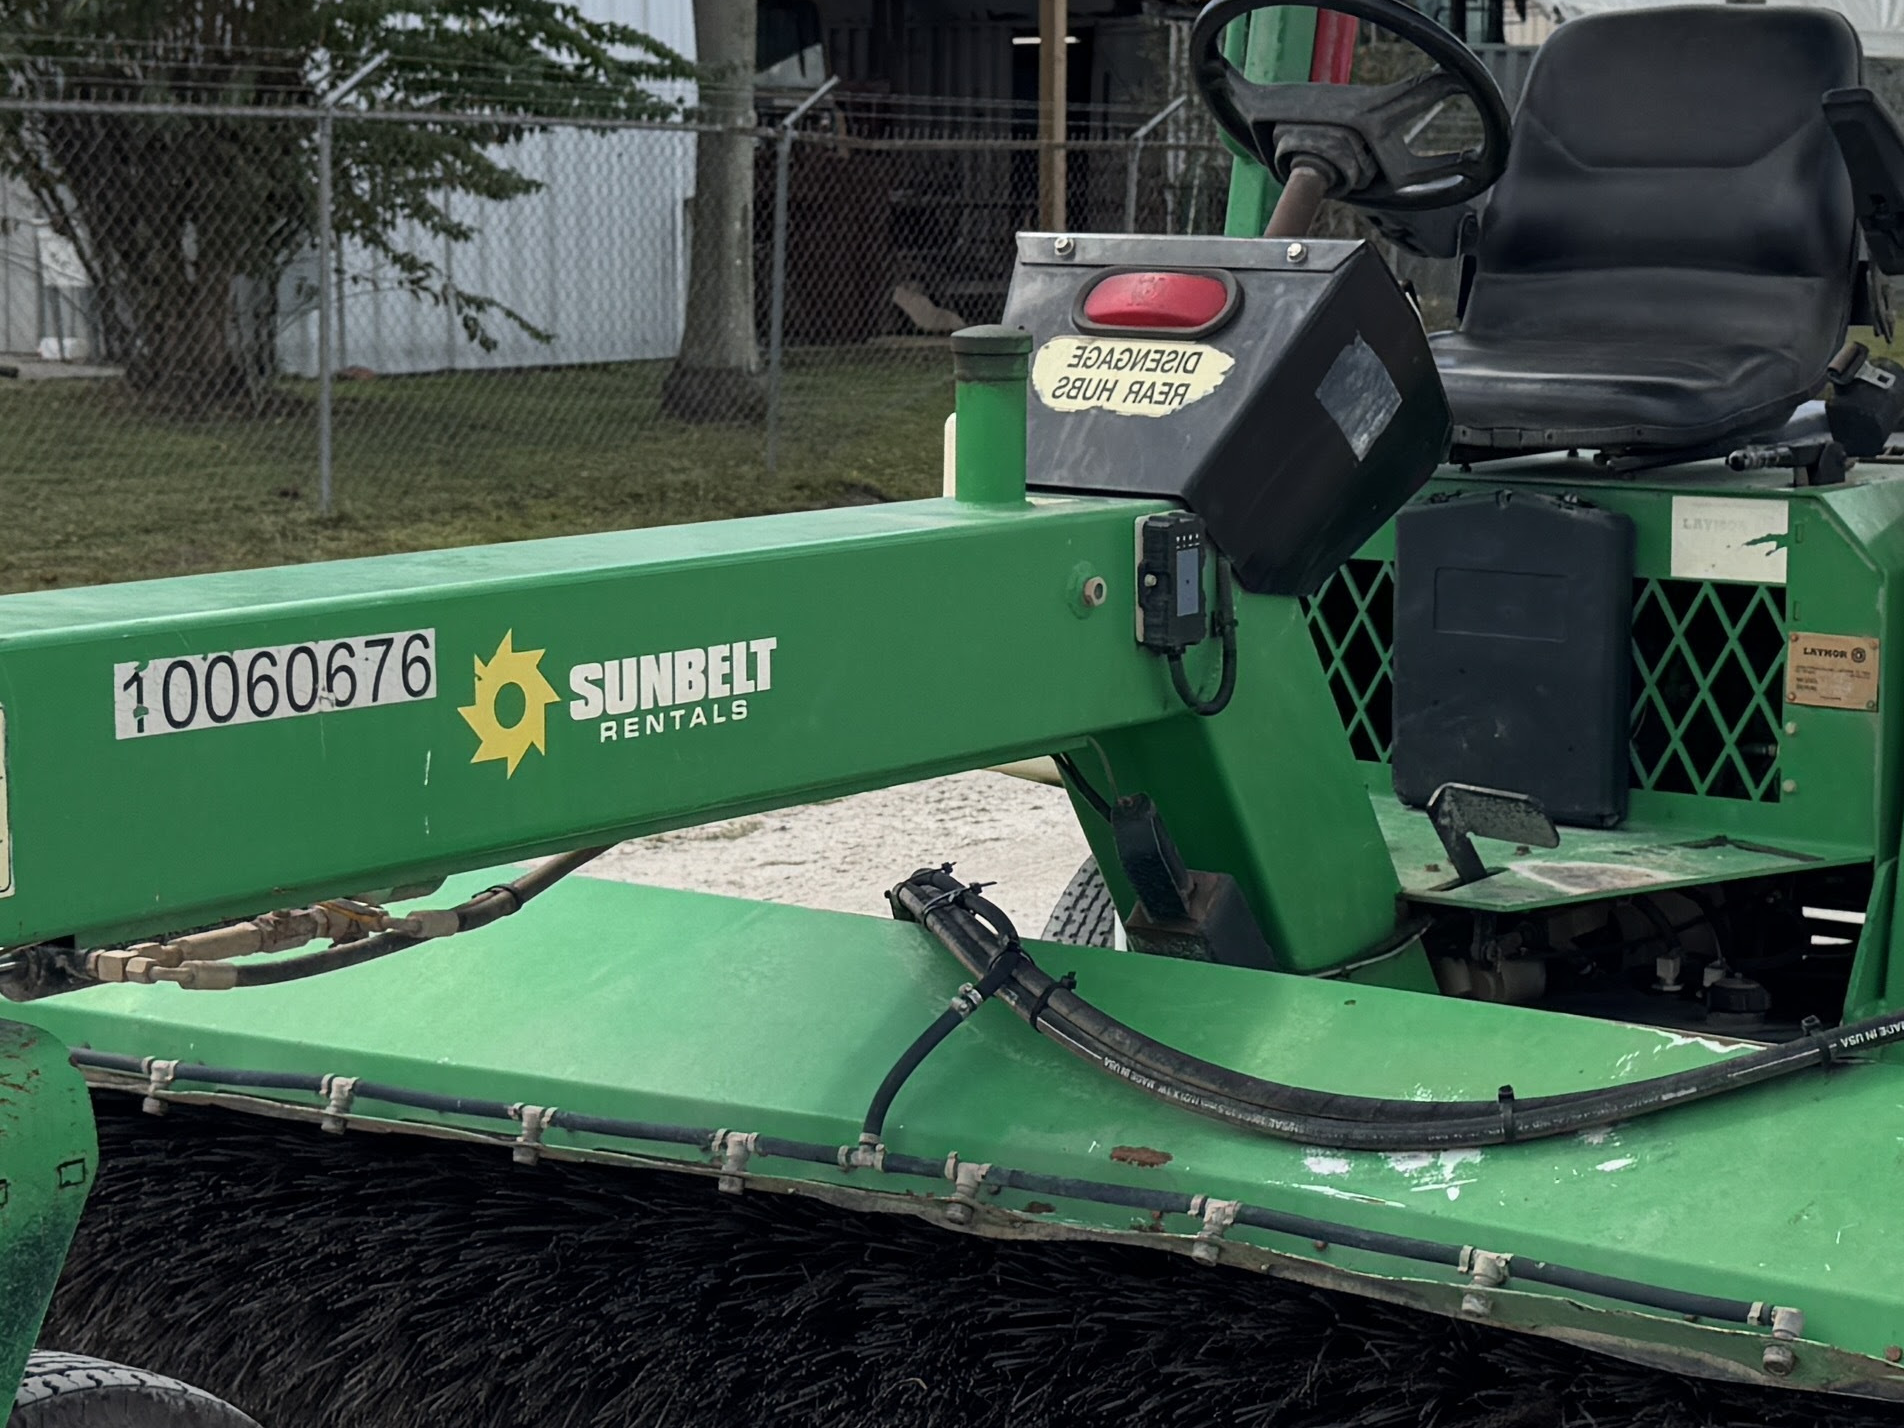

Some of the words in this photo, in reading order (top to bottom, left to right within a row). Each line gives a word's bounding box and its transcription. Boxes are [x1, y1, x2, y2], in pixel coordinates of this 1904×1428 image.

[122, 632, 432, 734] 10060676
[569, 637, 777, 721] SUNBELT
[600, 699, 748, 743] RENTALS
[1840, 1033, 1865, 1048] USA
[1866, 1030, 1878, 1041] IN
